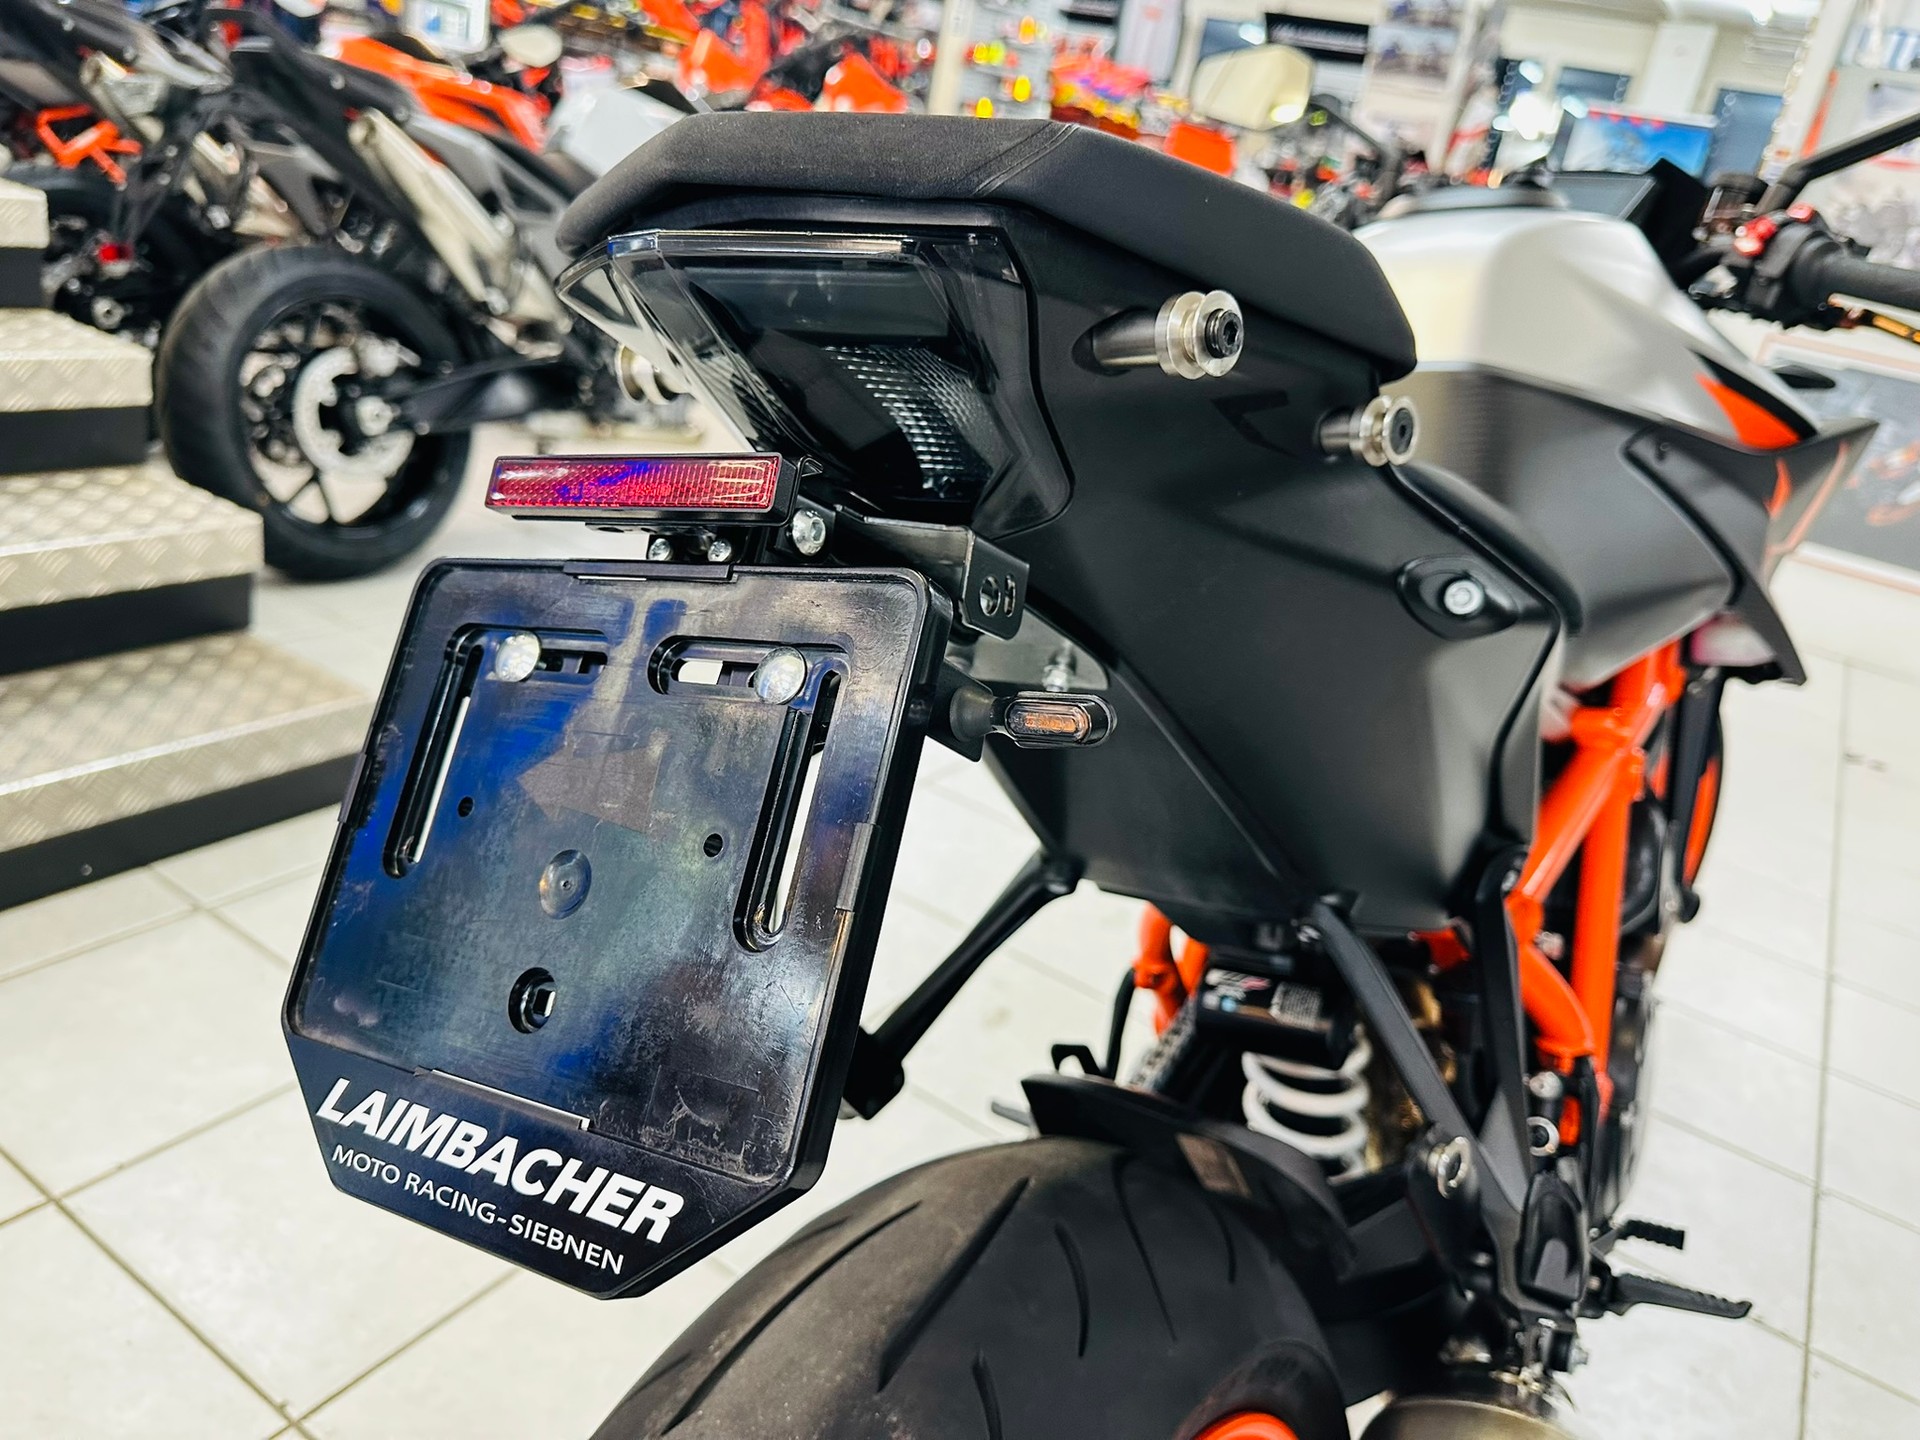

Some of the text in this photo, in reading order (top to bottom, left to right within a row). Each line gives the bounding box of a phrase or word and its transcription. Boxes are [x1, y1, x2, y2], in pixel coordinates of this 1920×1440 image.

[316, 1078, 684, 1243] LAIMBACHER
[332, 1145, 624, 1275] MOTO RACING-SIEBNEN
